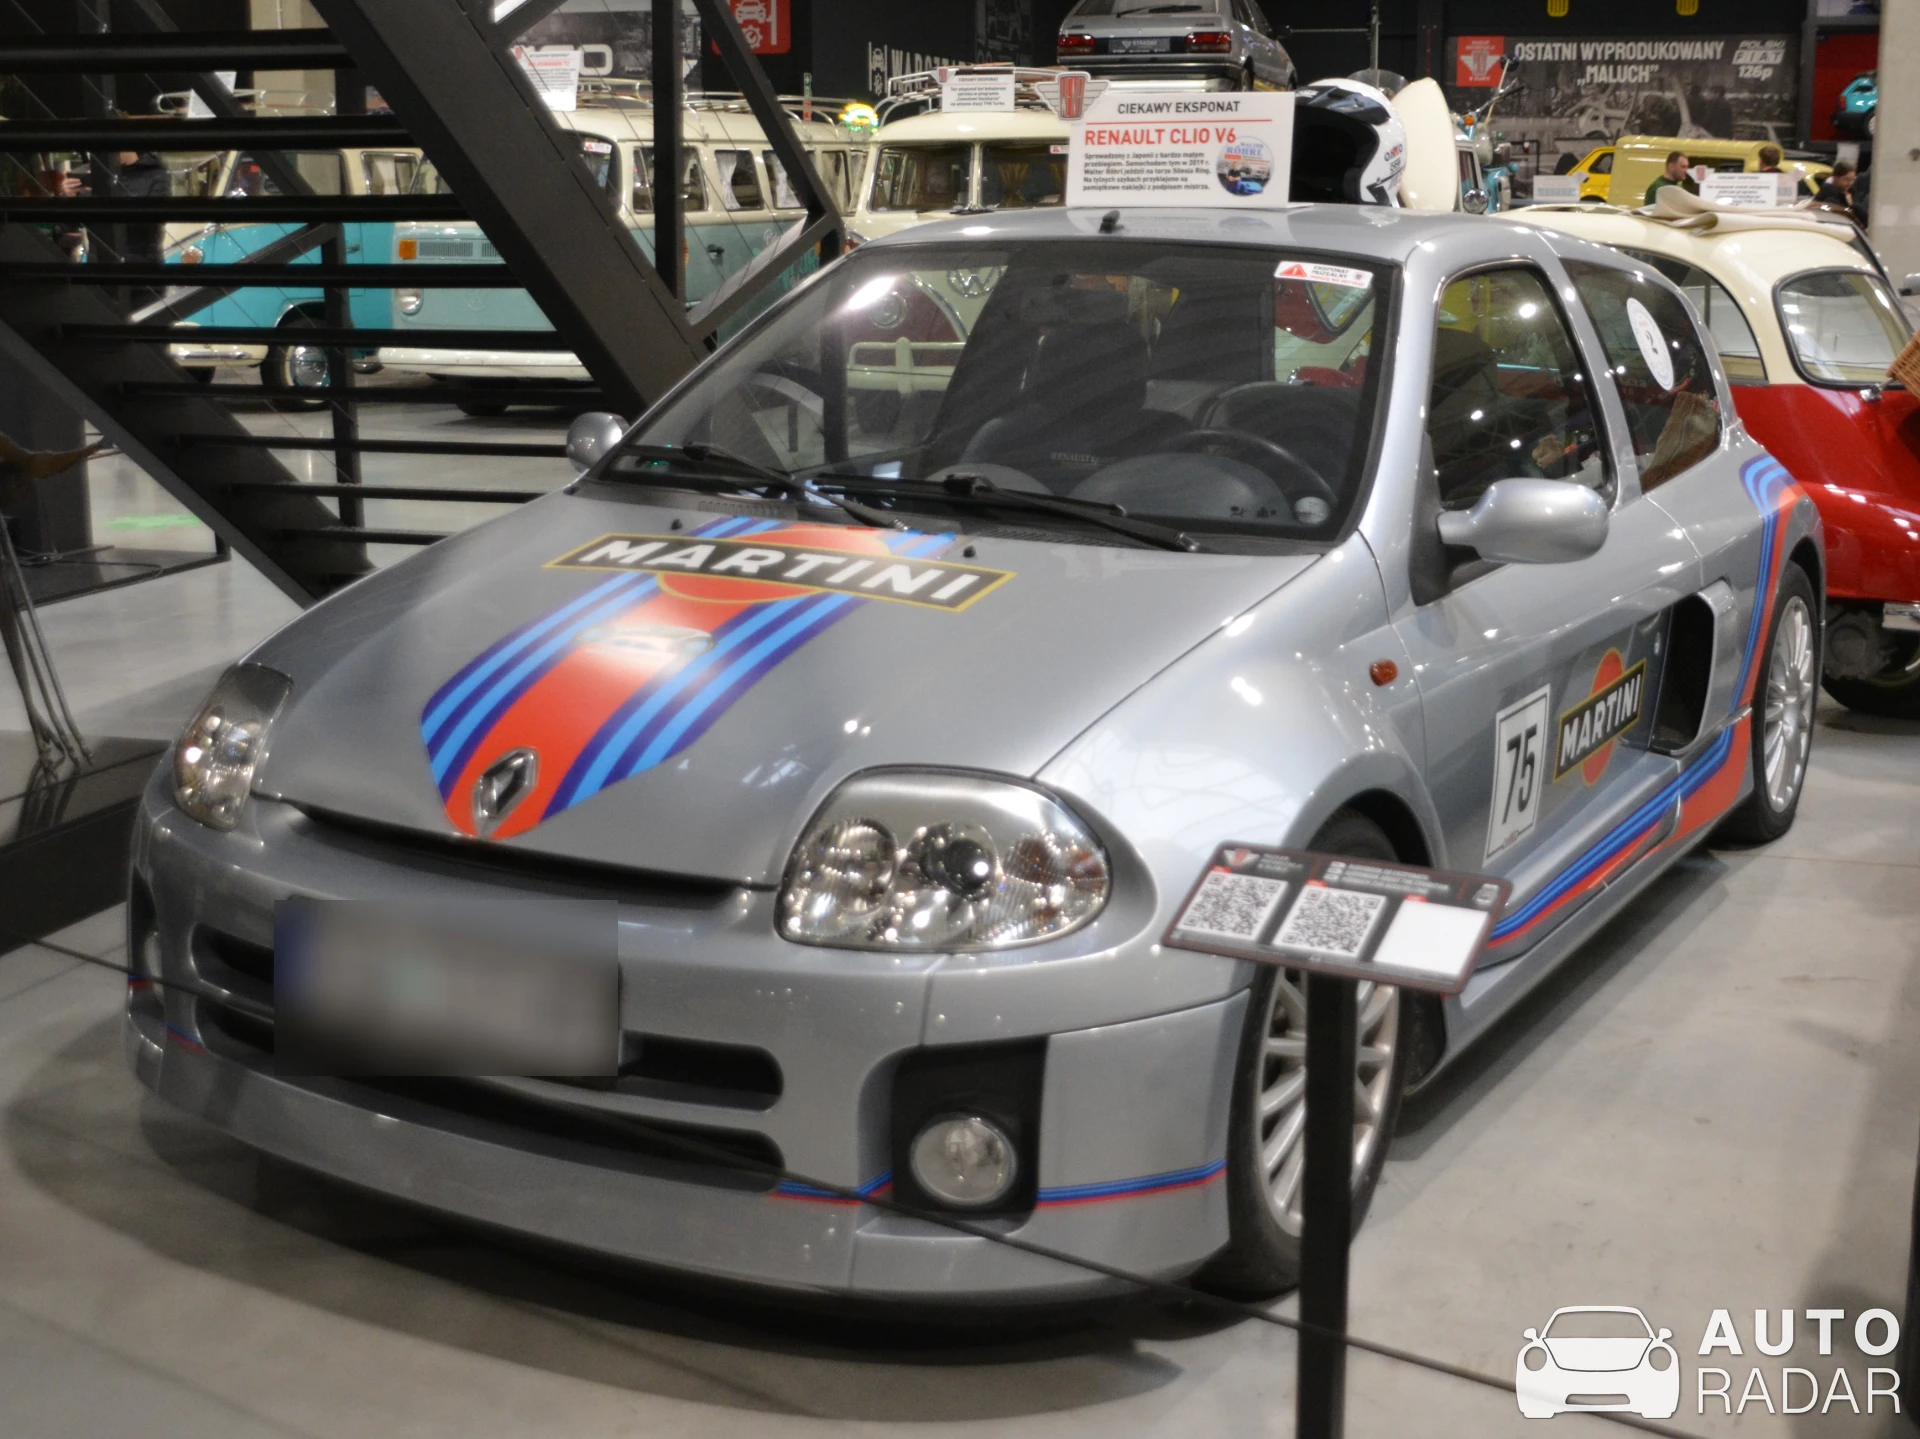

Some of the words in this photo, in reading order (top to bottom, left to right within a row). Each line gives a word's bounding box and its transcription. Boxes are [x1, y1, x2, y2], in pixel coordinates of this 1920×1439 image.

[1514, 42, 1577, 61] OSTATNI
[1580, 41, 1724, 61] WYPRODUKOWANY
[1739, 40, 1786, 49] POLSKI
[1733, 49, 1785, 64] FIAT
[1738, 65, 1773, 82] 126p
[1118, 102, 1172, 114] CIEKAWY
[1175, 101, 1240, 113] EKSPONAT
[1085, 129, 1165, 146] RENAULT
[1170, 128, 1210, 144] CLIO
[1215, 127, 1236, 144] V6
[579, 540, 980, 600] MARTINI
[1559, 673, 1641, 767] MARTINI
[1502, 723, 1538, 825] 75
